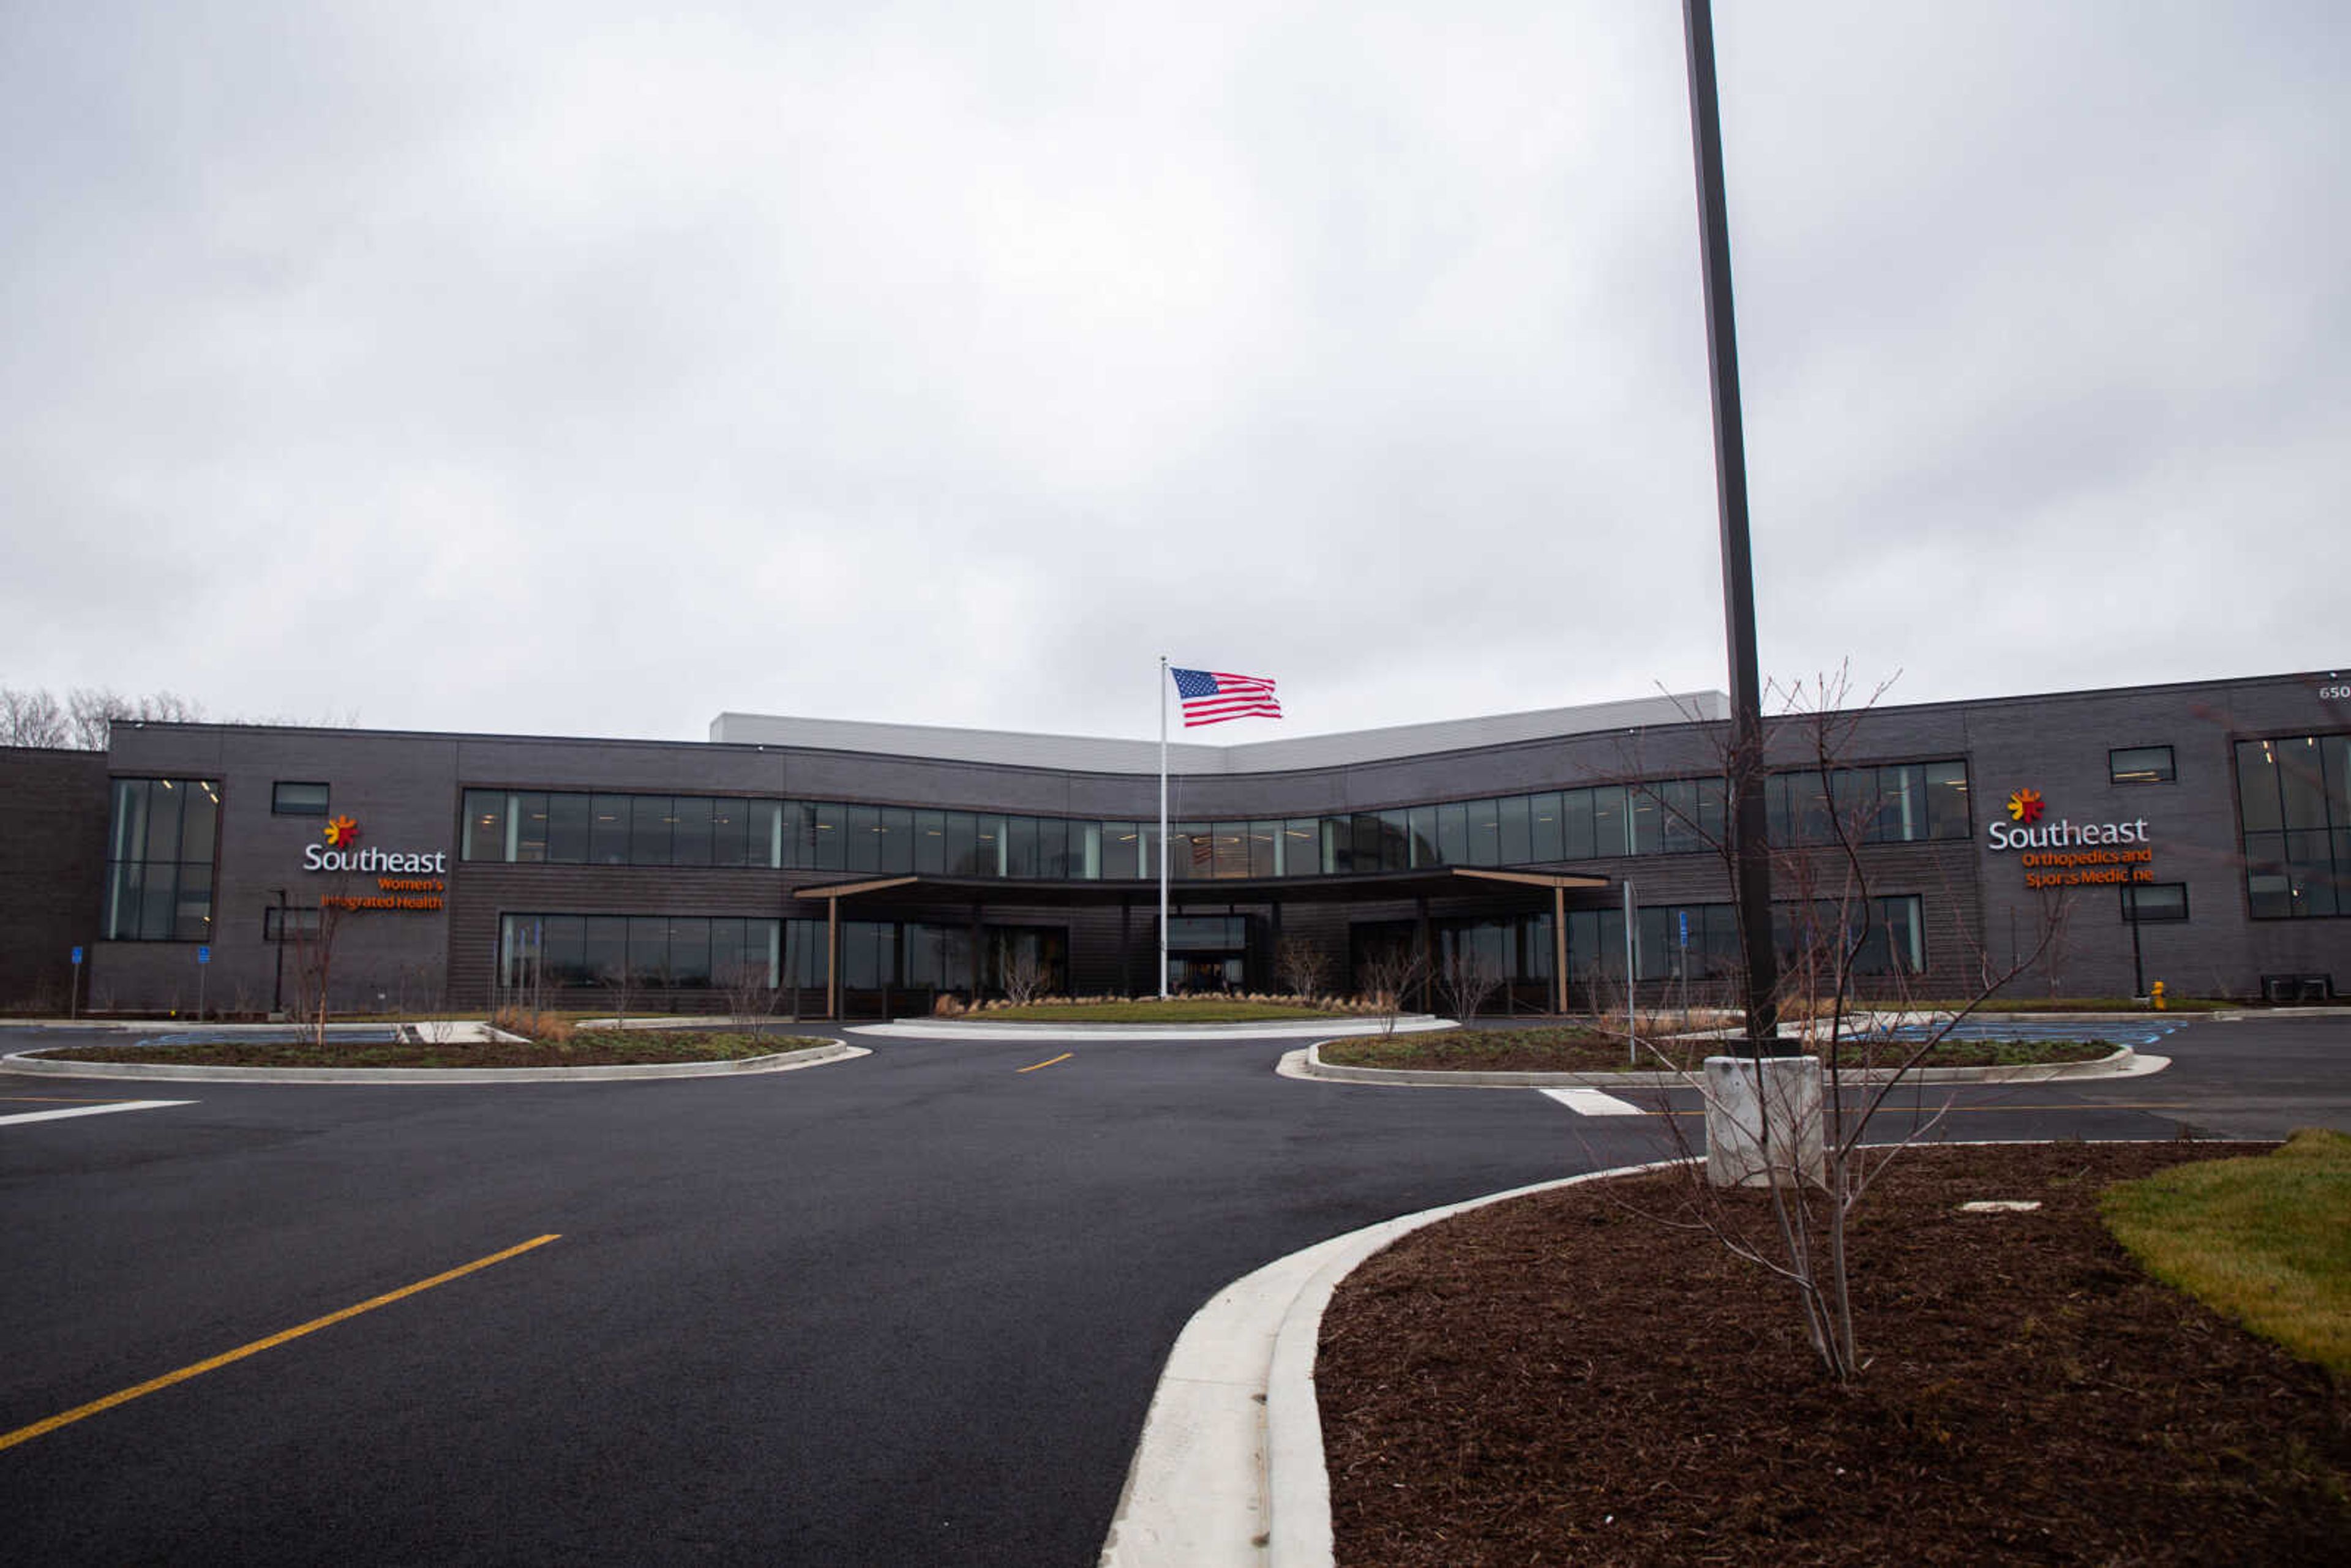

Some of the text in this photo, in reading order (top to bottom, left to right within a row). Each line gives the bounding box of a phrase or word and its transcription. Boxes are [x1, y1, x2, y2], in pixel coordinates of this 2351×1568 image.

[2320, 686, 2350, 699] 650
[1989, 817, 2150, 850] Southeast
[303, 843, 446, 873] Southeast
[2022, 847, 2152, 868] Orthopedics and
[2081, 868, 2154, 883] Medicne
[378, 877, 444, 891] Women's
[397, 895, 444, 909] Health
